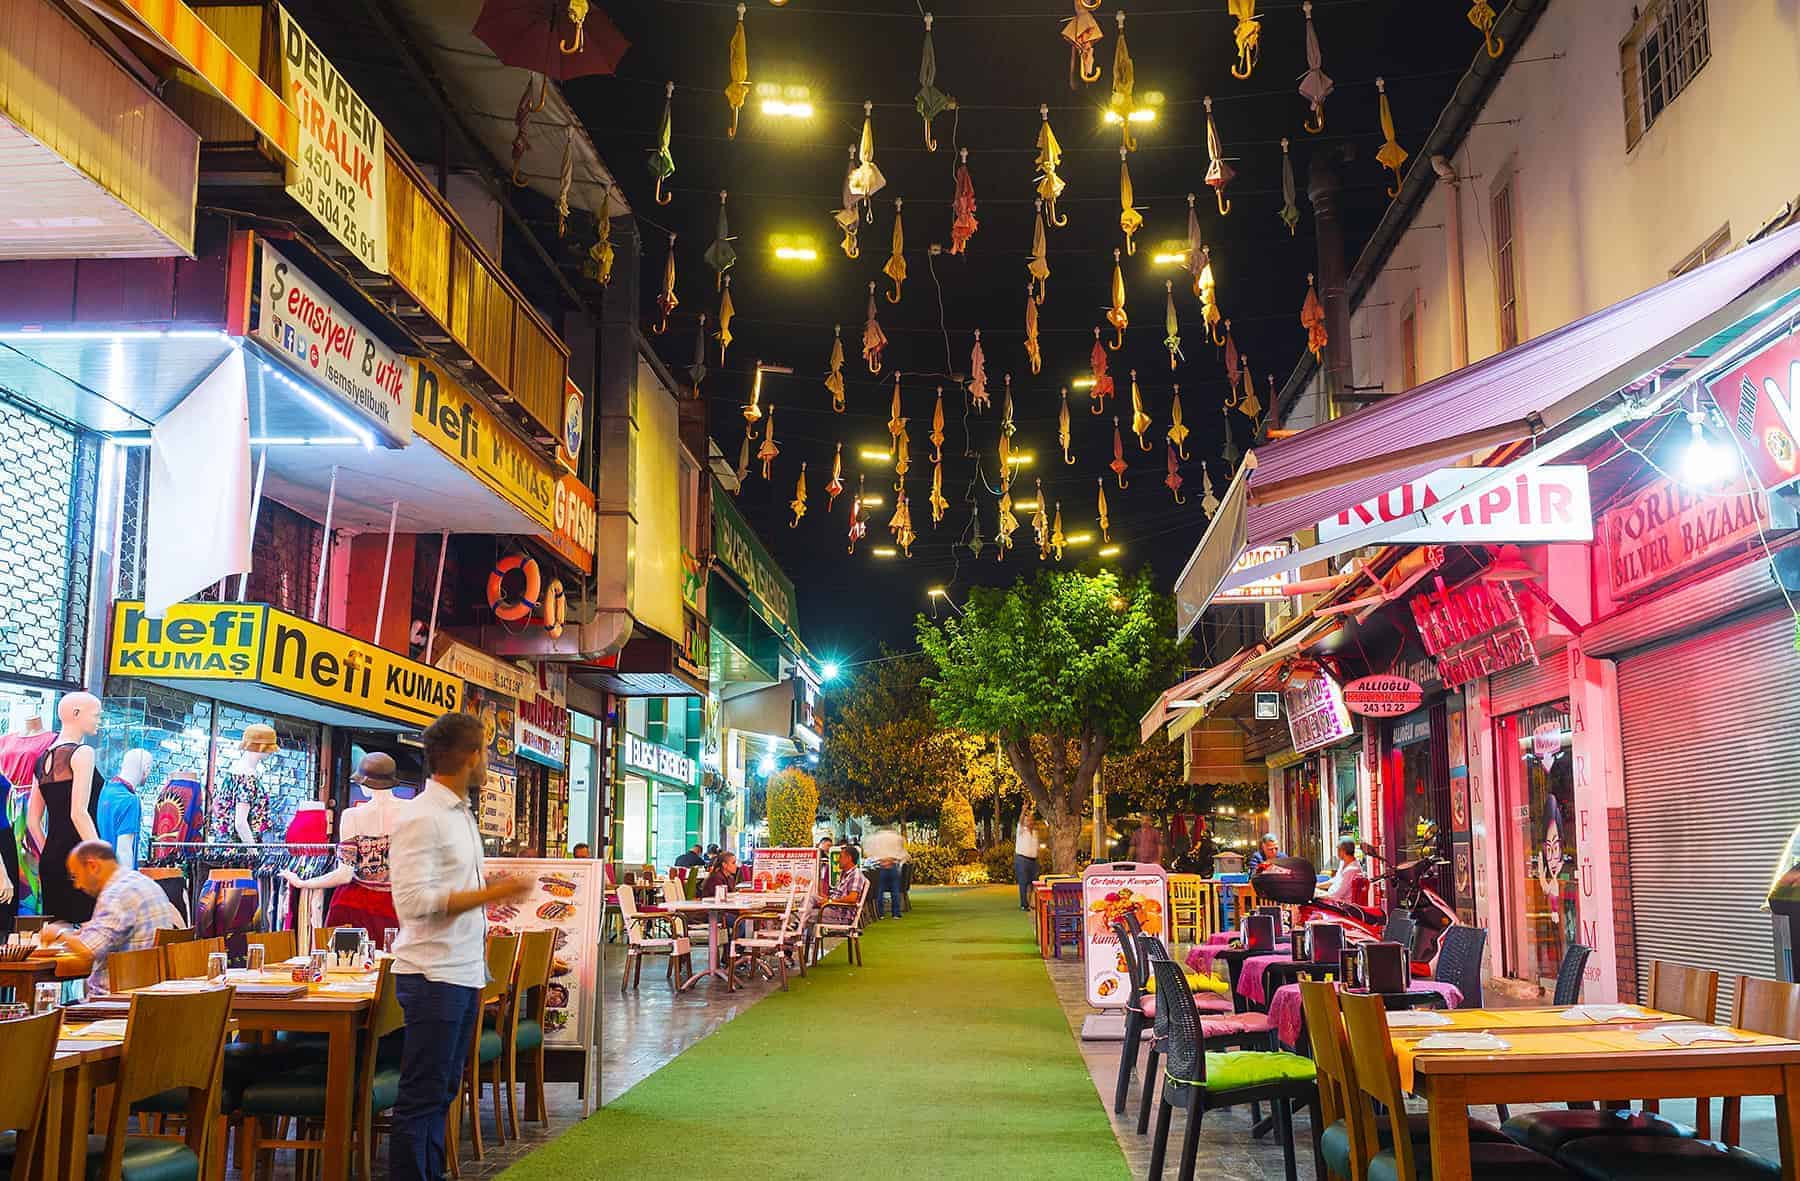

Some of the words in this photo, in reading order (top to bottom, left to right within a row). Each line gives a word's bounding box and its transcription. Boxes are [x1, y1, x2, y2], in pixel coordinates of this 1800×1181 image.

[286, 17, 377, 156] DEVREN
[303, 143, 332, 187] 450
[335, 178, 356, 213] m2
[316, 186, 339, 231] 504
[343, 213, 357, 248] 25
[360, 231, 376, 263] 61
[361, 338, 404, 405] Butik
[415, 361, 479, 461] nefi
[1615, 534, 1673, 588] SILVER
[1681, 490, 1766, 553] BAZAAR
[119, 649, 251, 676] KUMAŞ
[122, 607, 256, 648] nefi
[272, 623, 374, 699] nefi
[385, 663, 458, 714] KUMAŞ
[1363, 703, 1379, 713] 243
[1383, 703, 1393, 712] 12
[1394, 703, 1406, 712] 22
[1090, 932, 1122, 948] kump
